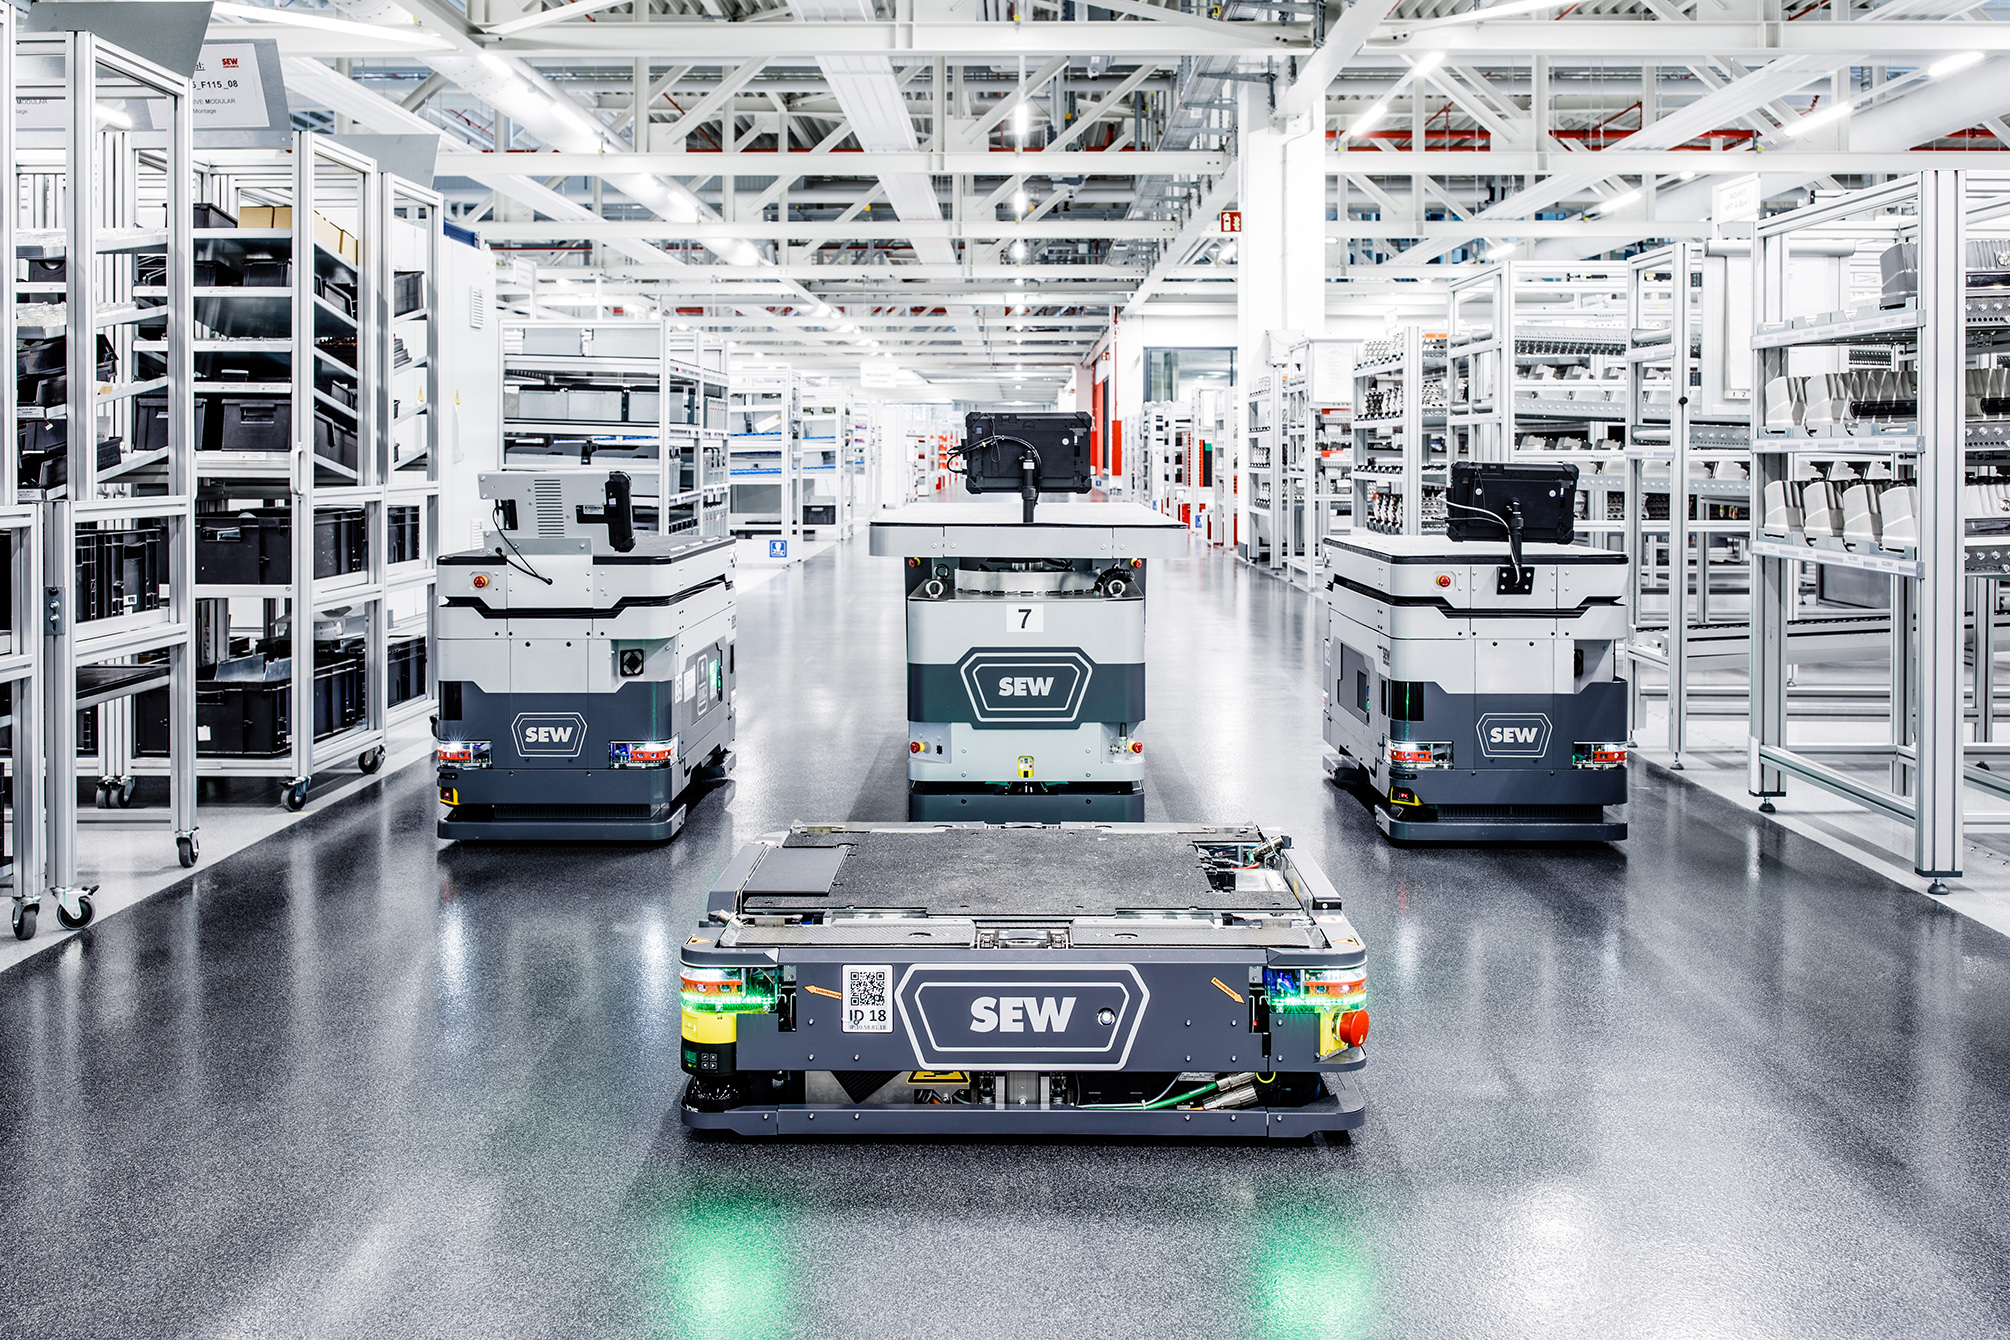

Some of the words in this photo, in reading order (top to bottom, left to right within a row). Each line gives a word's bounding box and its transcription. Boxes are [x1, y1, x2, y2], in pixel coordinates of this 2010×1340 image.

[1018, 608, 1032, 629] 7
[998, 677, 1055, 697] SEW
[524, 727, 574, 744] SEW
[1490, 727, 1539, 744] SEW
[849, 1010, 864, 1021] ID
[870, 1010, 887, 1022] 18
[969, 996, 1077, 1033] SEW
